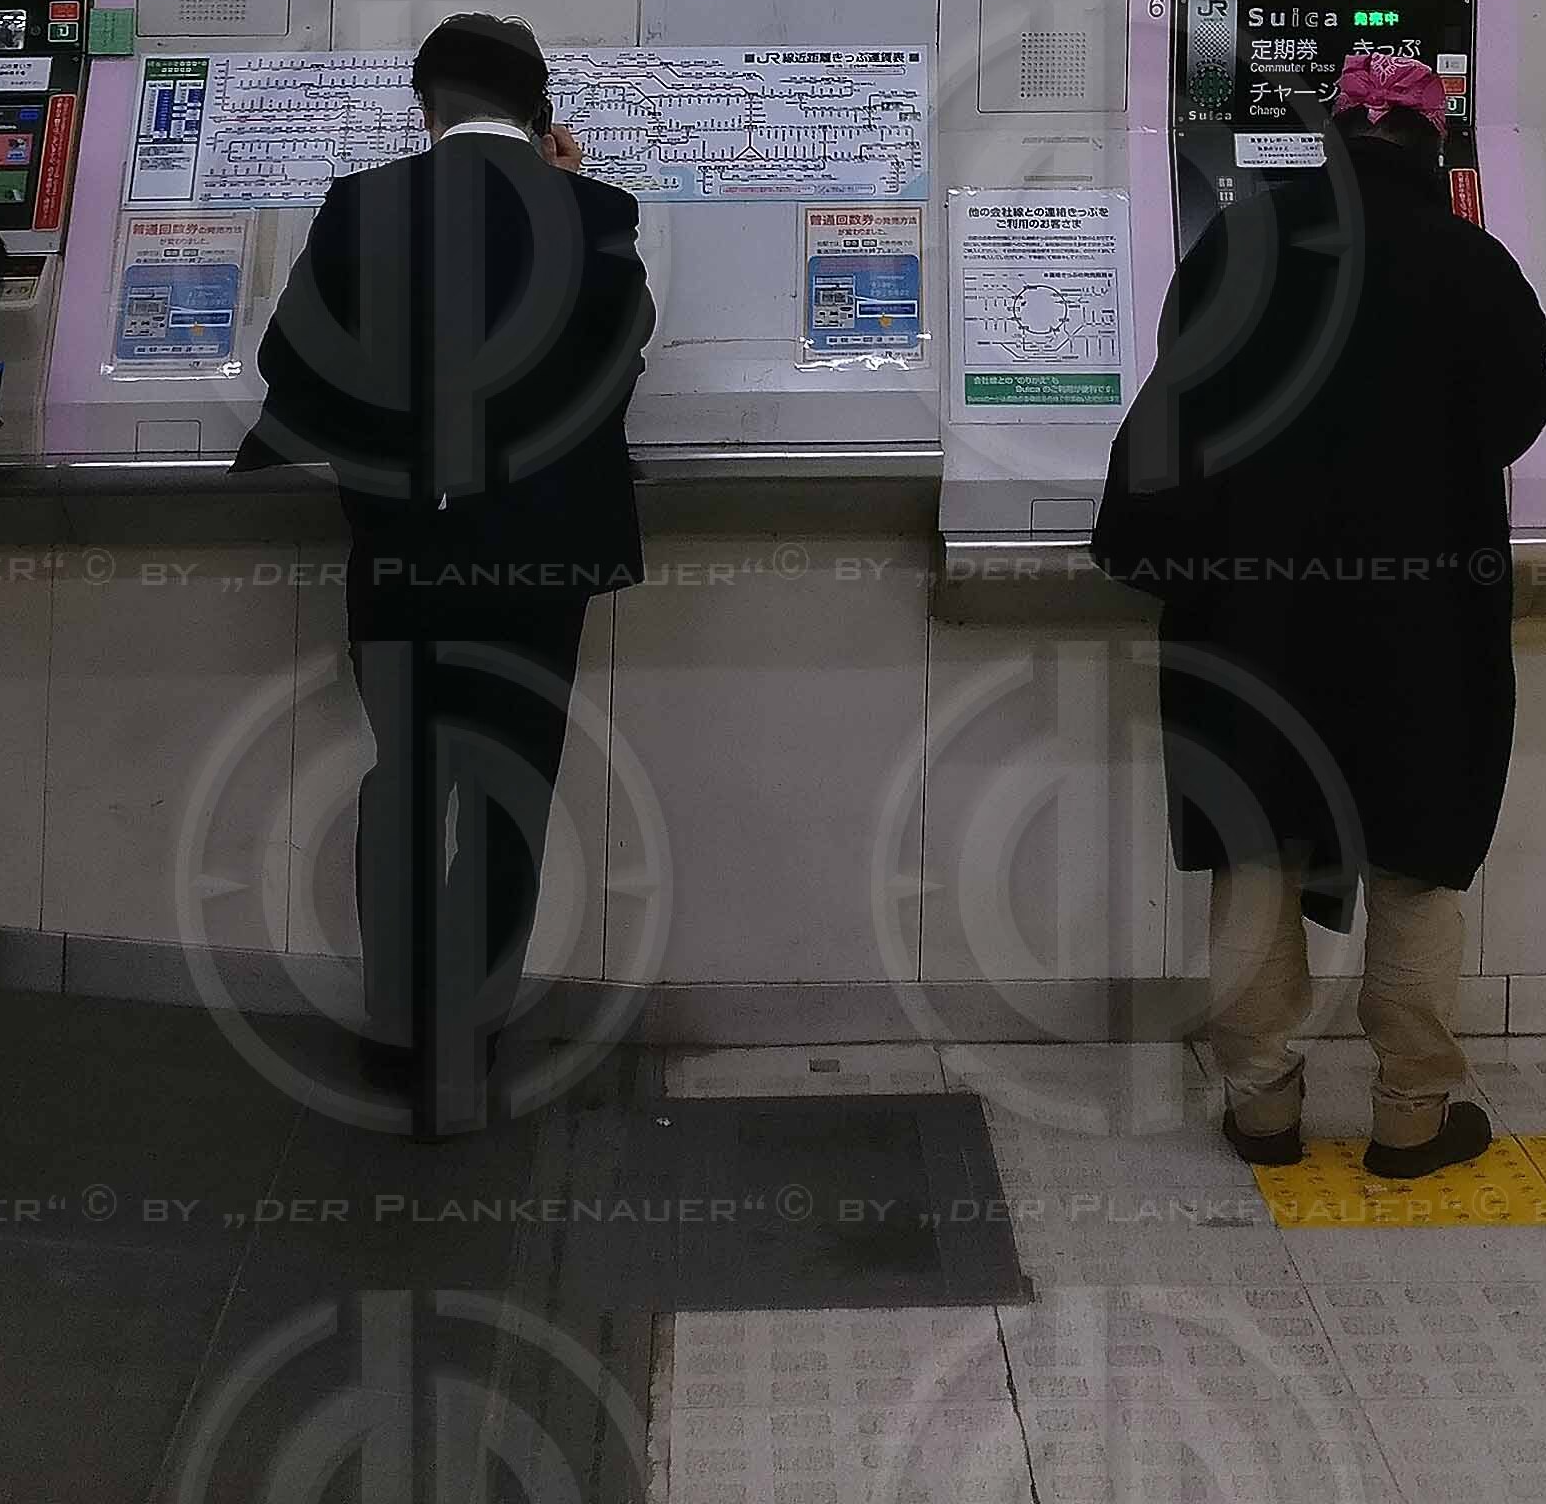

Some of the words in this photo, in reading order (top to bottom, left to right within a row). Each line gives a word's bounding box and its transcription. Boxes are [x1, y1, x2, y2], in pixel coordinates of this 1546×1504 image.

[1248, 7, 1338, 28] Suica
[1251, 39, 1318, 61] 定期券
[1250, 62, 1305, 74] Commuter
[1311, 62, 1335, 73] Pass
[1249, 106, 1286, 117] Charge
